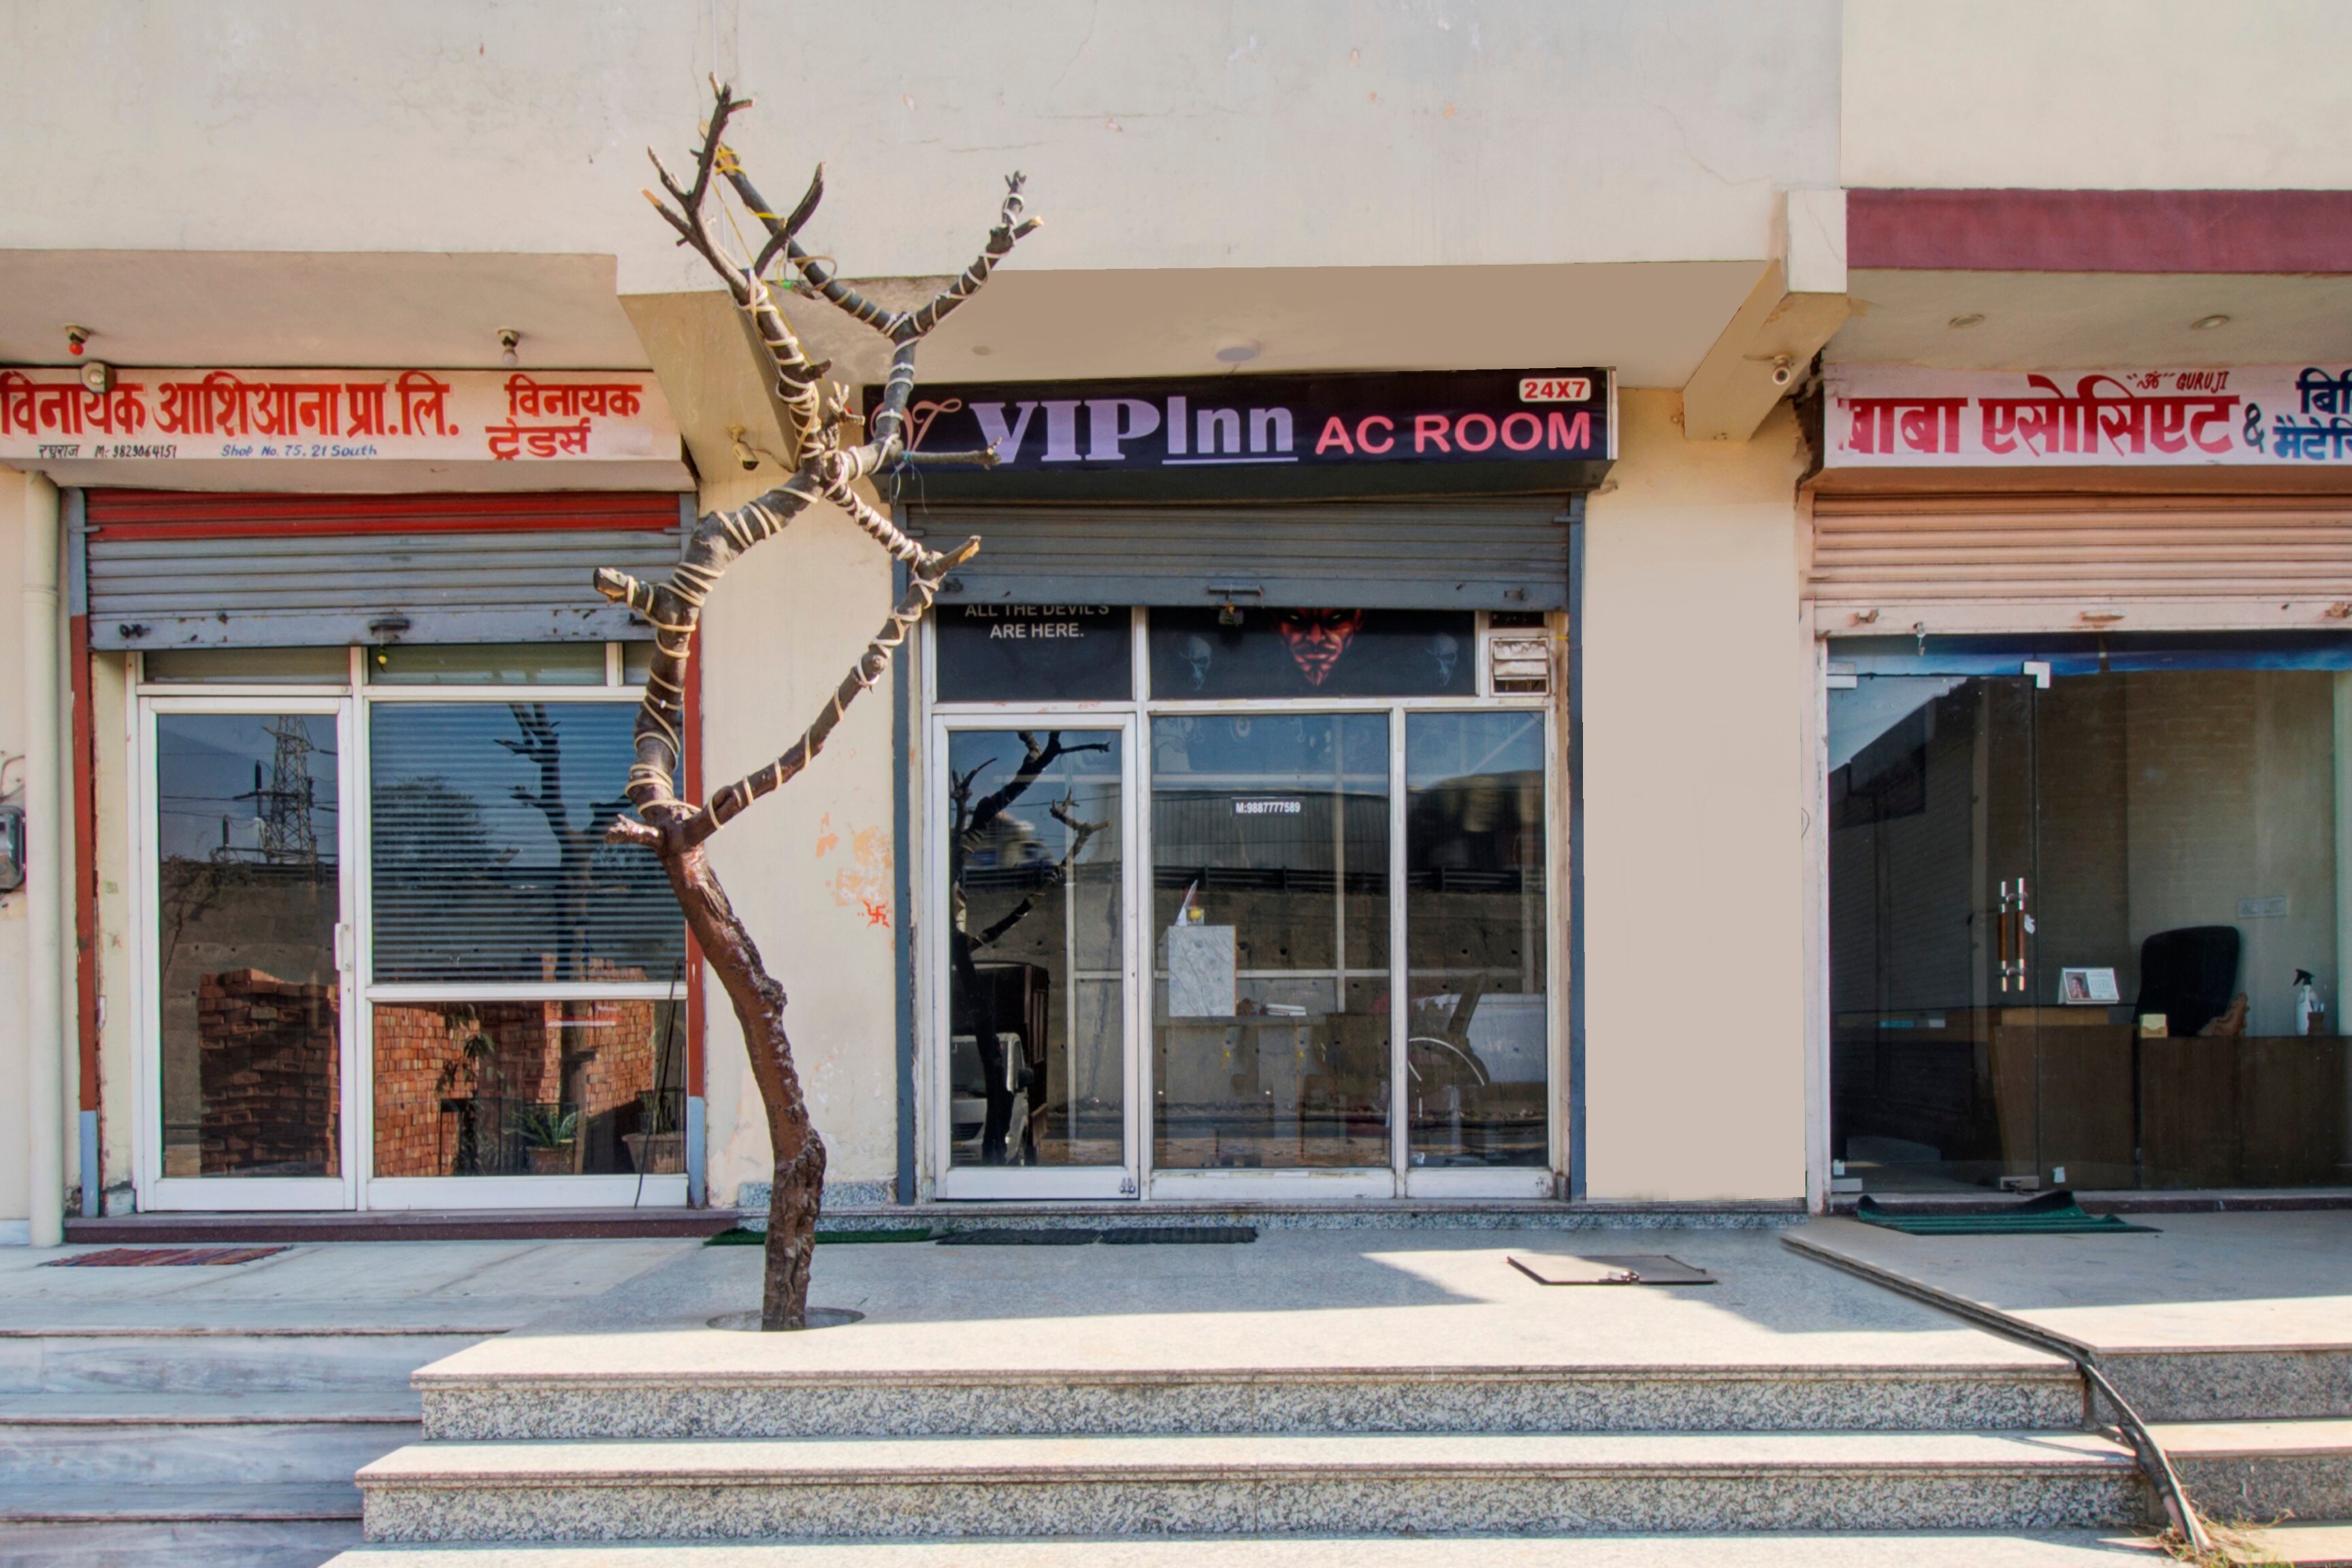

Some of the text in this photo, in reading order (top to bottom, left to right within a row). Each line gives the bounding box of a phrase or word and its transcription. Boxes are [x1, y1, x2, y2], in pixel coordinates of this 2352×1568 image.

[1524, 381, 1586, 399] 24X7
[2176, 372, 2230, 393] GURUJI
[0, 371, 146, 435] विनायक
[504, 374, 643, 417] विनायक
[1978, 374, 2240, 457] एसोसिएट
[2242, 402, 2265, 454] &
[968, 399, 1161, 463] VIP
[1167, 397, 1294, 455] Inn
[1315, 416, 1394, 455] AC
[1414, 411, 1591, 453] ROOM
[312, 444, 327, 457] 21
[331, 444, 378, 457] South
[965, 605, 998, 617] ALL
[1006, 605, 1038, 616] THE
[990, 623, 1085, 639] ARE HERE.
